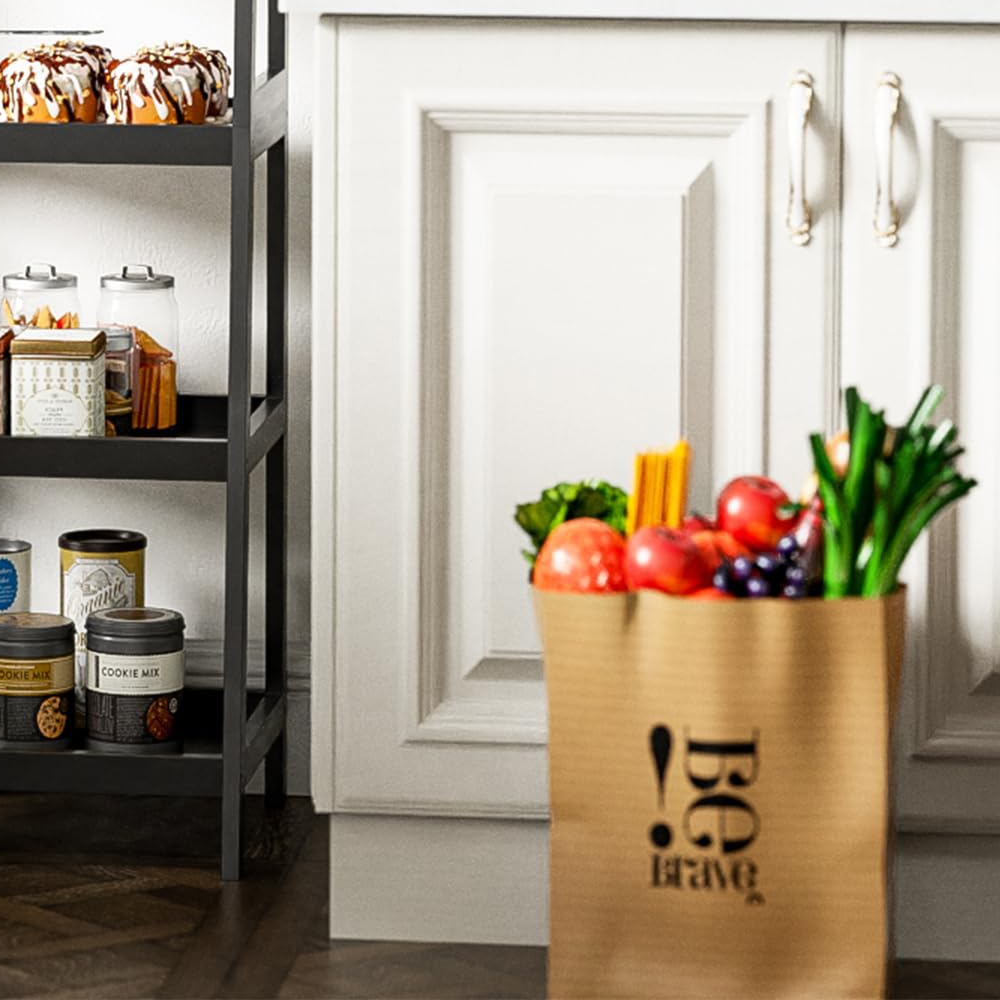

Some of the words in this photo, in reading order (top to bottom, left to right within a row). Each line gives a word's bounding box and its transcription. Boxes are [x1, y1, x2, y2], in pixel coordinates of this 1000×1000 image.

[32, 670, 51, 680] MIX
[101, 665, 139, 678] COOKIE
[141, 667, 160, 678] MIX
[650, 854, 759, 892] Brave
